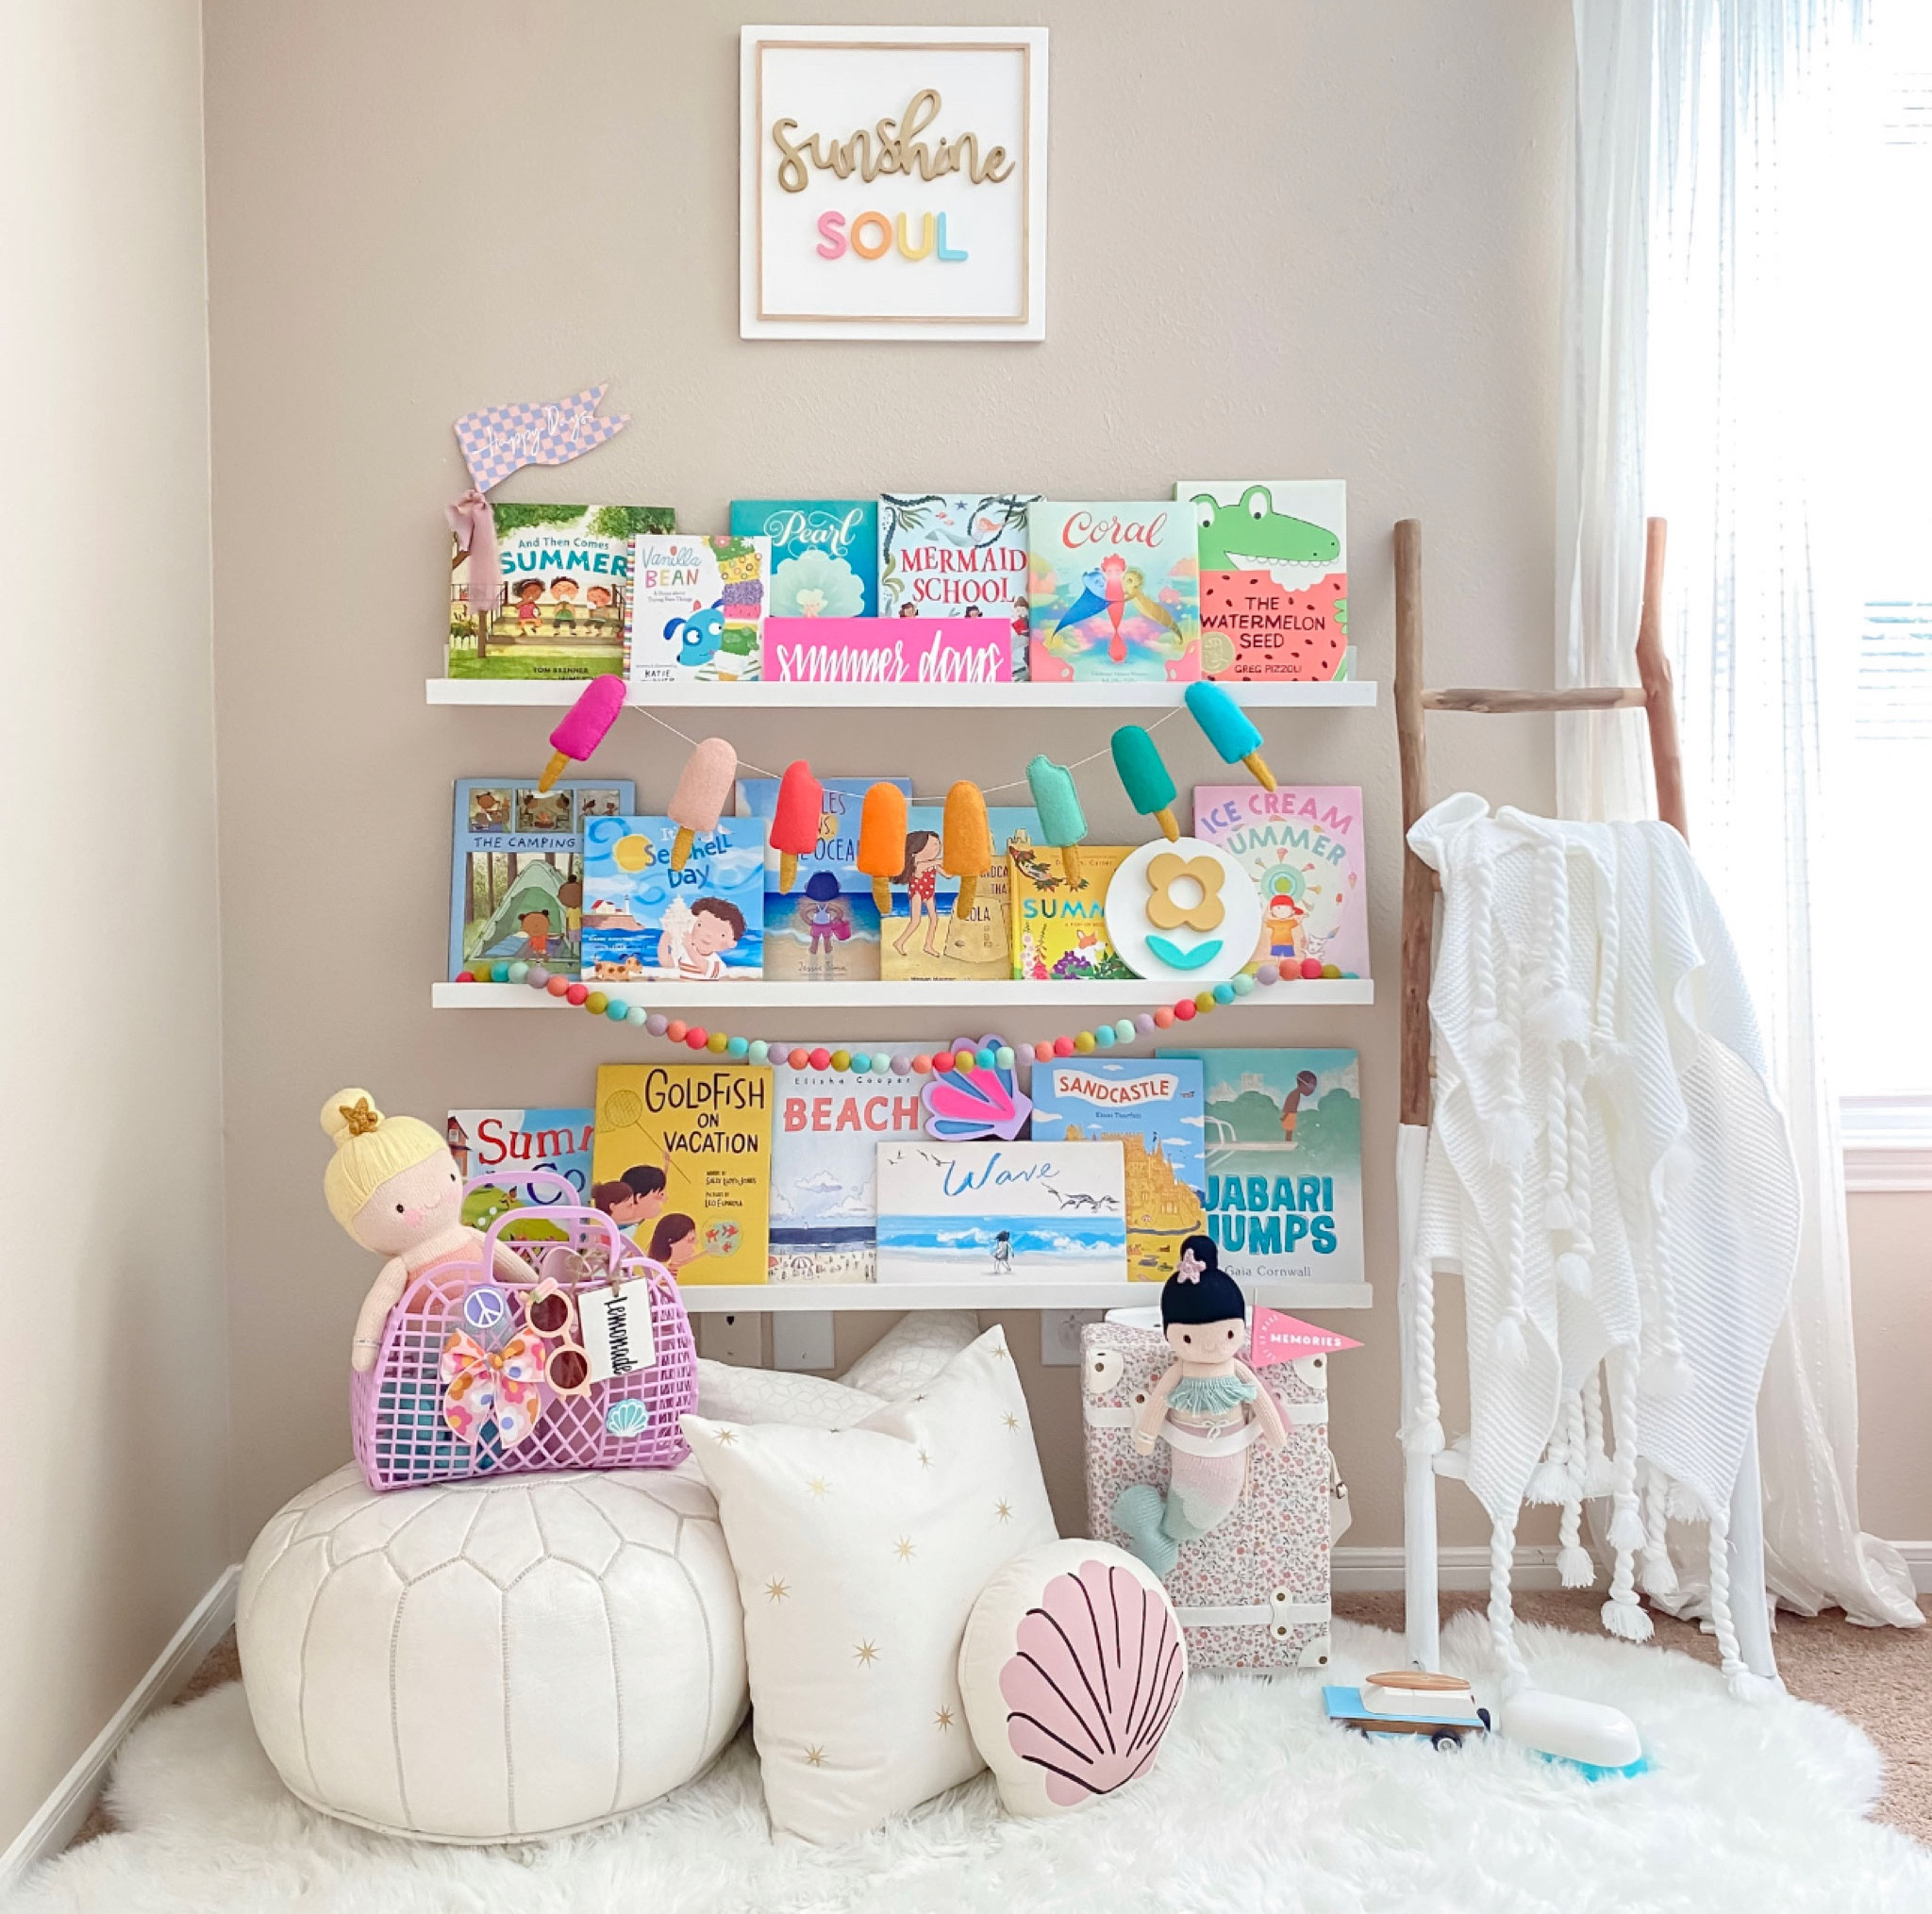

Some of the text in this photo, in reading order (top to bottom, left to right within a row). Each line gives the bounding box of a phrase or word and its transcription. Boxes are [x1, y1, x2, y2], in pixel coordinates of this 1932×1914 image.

[772, 89, 1016, 193] sunshine
[816, 210, 969, 261] SOUL
[472, 406, 593, 458] Happy Days
[763, 508, 864, 558] Pearl
[1062, 511, 1168, 549] Coral
[518, 537, 609, 551] And Then Comes
[641, 545, 702, 569] Vanilla
[500, 549, 627, 577] SUMMER
[901, 546, 1027, 573] MERMAID
[645, 569, 699, 589] BEAN
[912, 577, 1015, 605] SCHOOL
[1244, 596, 1280, 611] THE
[1200, 613, 1325, 631] WATERMELON
[1240, 633, 1284, 649] SEED
[776, 629, 1004, 682] summer days
[1234, 664, 1262, 674] GREG
[1201, 793, 1353, 835] ICE CREAM
[474, 837, 576, 848] THE CAMPING
[1216, 825, 1346, 866] UMMER
[667, 864, 709, 890] Day
[991, 883, 1008, 895] THA
[645, 1069, 765, 1112] GOLDFISH
[795, 1076, 910, 1085] Elisha Cooper
[1059, 1076, 1169, 1103] SANDCASTLE
[697, 1113, 720, 1129] ON
[783, 1095, 919, 1131] BEACH
[663, 1131, 758, 1154] VACATION
[943, 1153, 1059, 1196] Wave
[1206, 1174, 1333, 1212] JABARI
[1208, 1214, 1337, 1255] JUMPS
[1224, 1265, 1311, 1276] Gaia Cornwall
[604, 1295, 638, 1375] Lemonade
[1271, 1333, 1341, 1347] MEMORIES
